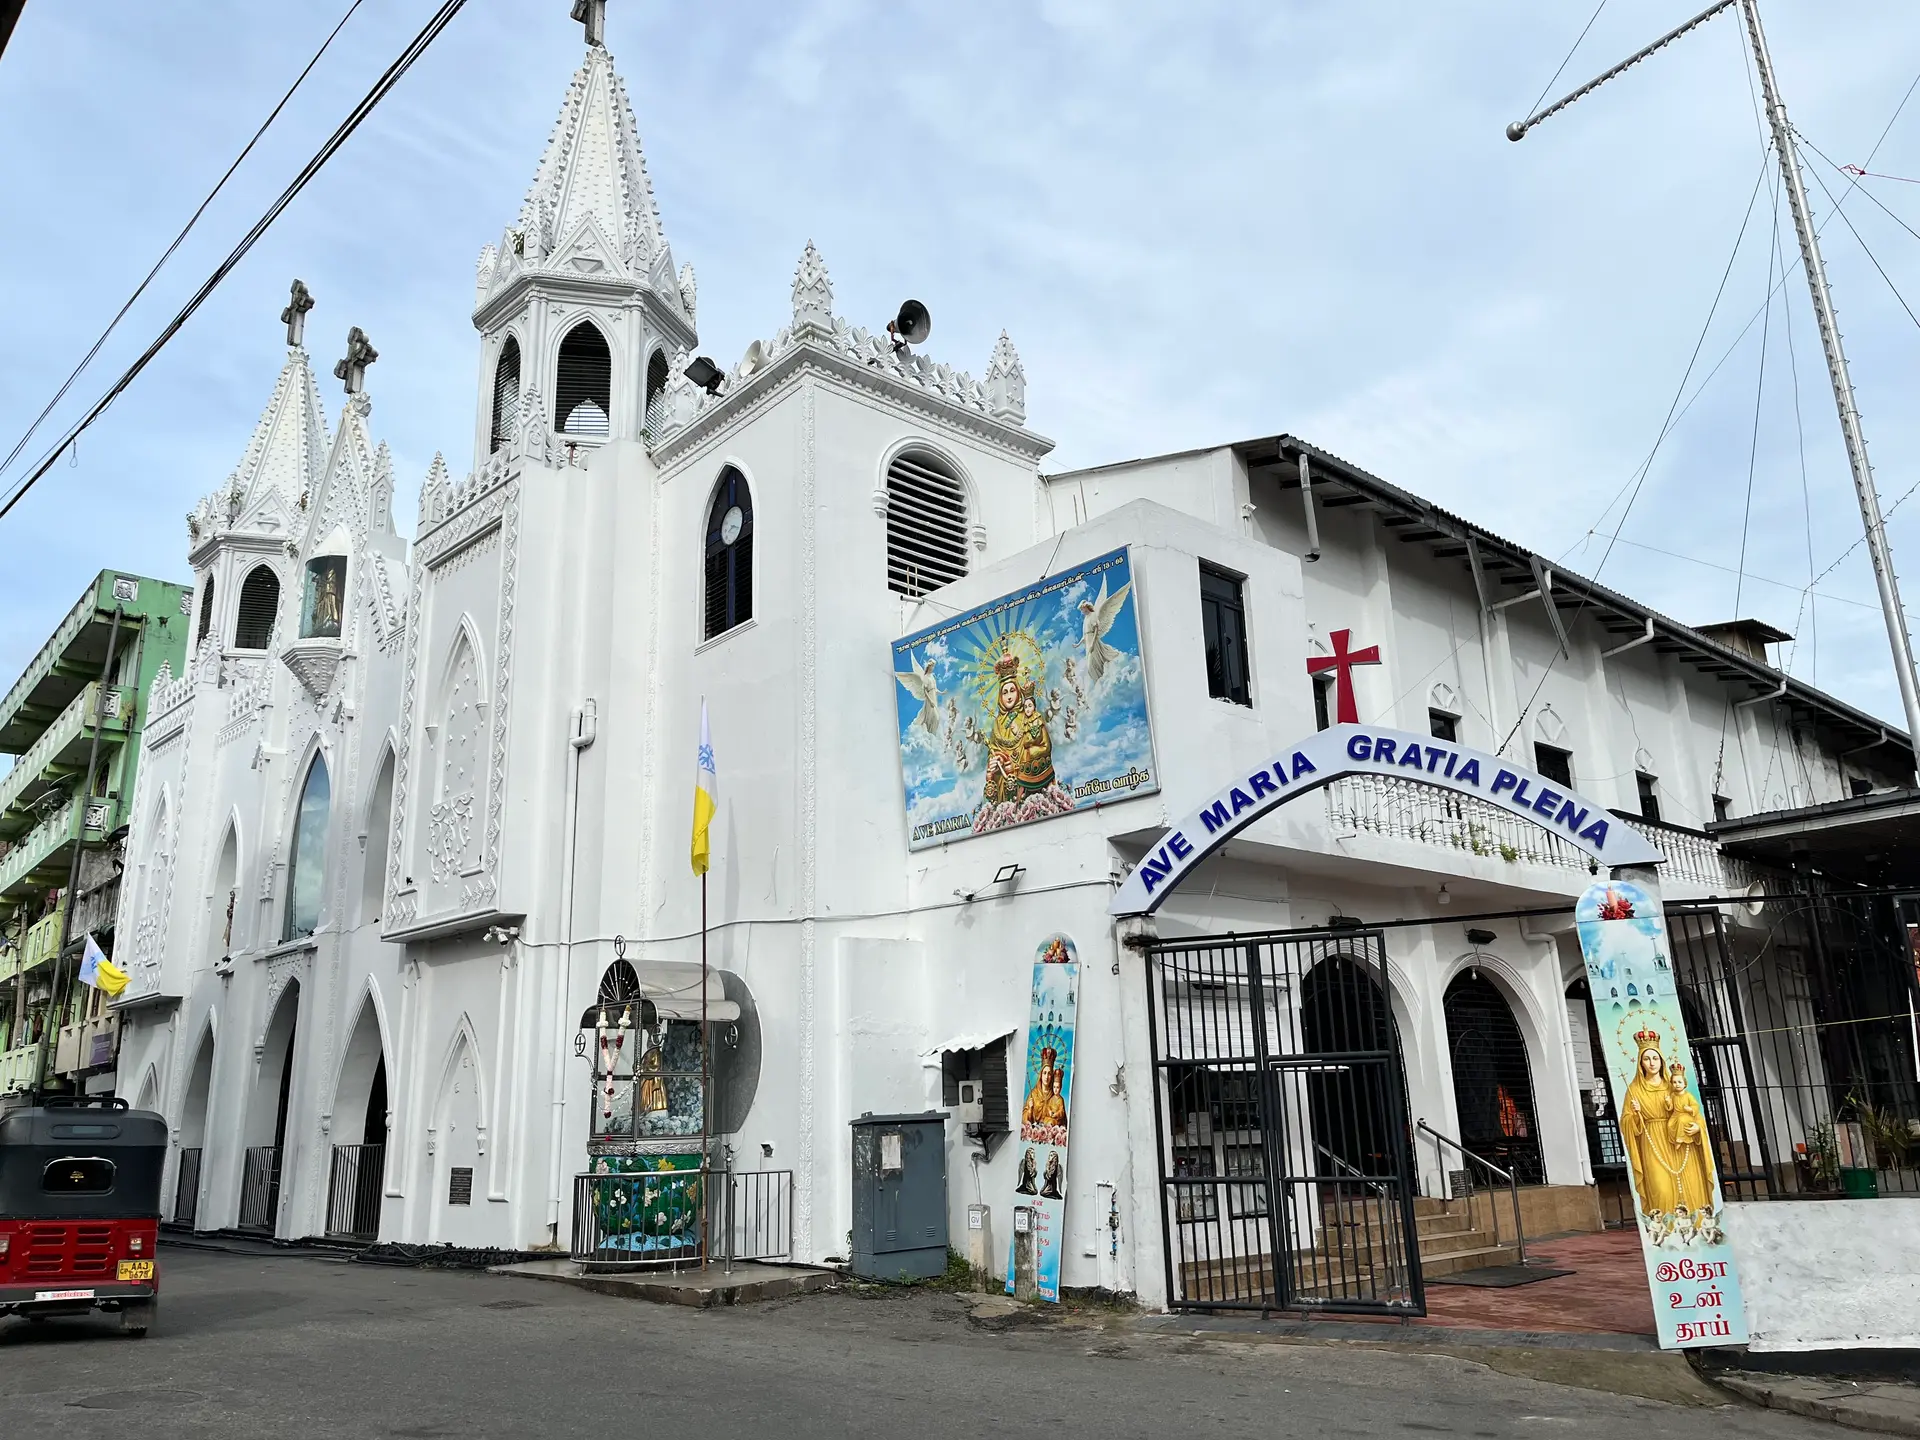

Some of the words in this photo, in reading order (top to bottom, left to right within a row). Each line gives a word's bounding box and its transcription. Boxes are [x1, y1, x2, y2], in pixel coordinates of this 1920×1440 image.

[1074, 777, 1110, 799] மரியே
[1112, 767, 1150, 792] வாழ்க
[912, 822, 934, 841] AVE
[934, 813, 972, 835] MARIA
[1139, 831, 1195, 895] AVE
[1199, 751, 1318, 835] MARIA
[1346, 734, 1481, 788] GRATIA
[1490, 768, 1610, 851] PLENA
[1655, 1258, 1729, 1284] இதோ
[1669, 1284, 1725, 1309] உன்
[1676, 1313, 1732, 1344] தாய்
